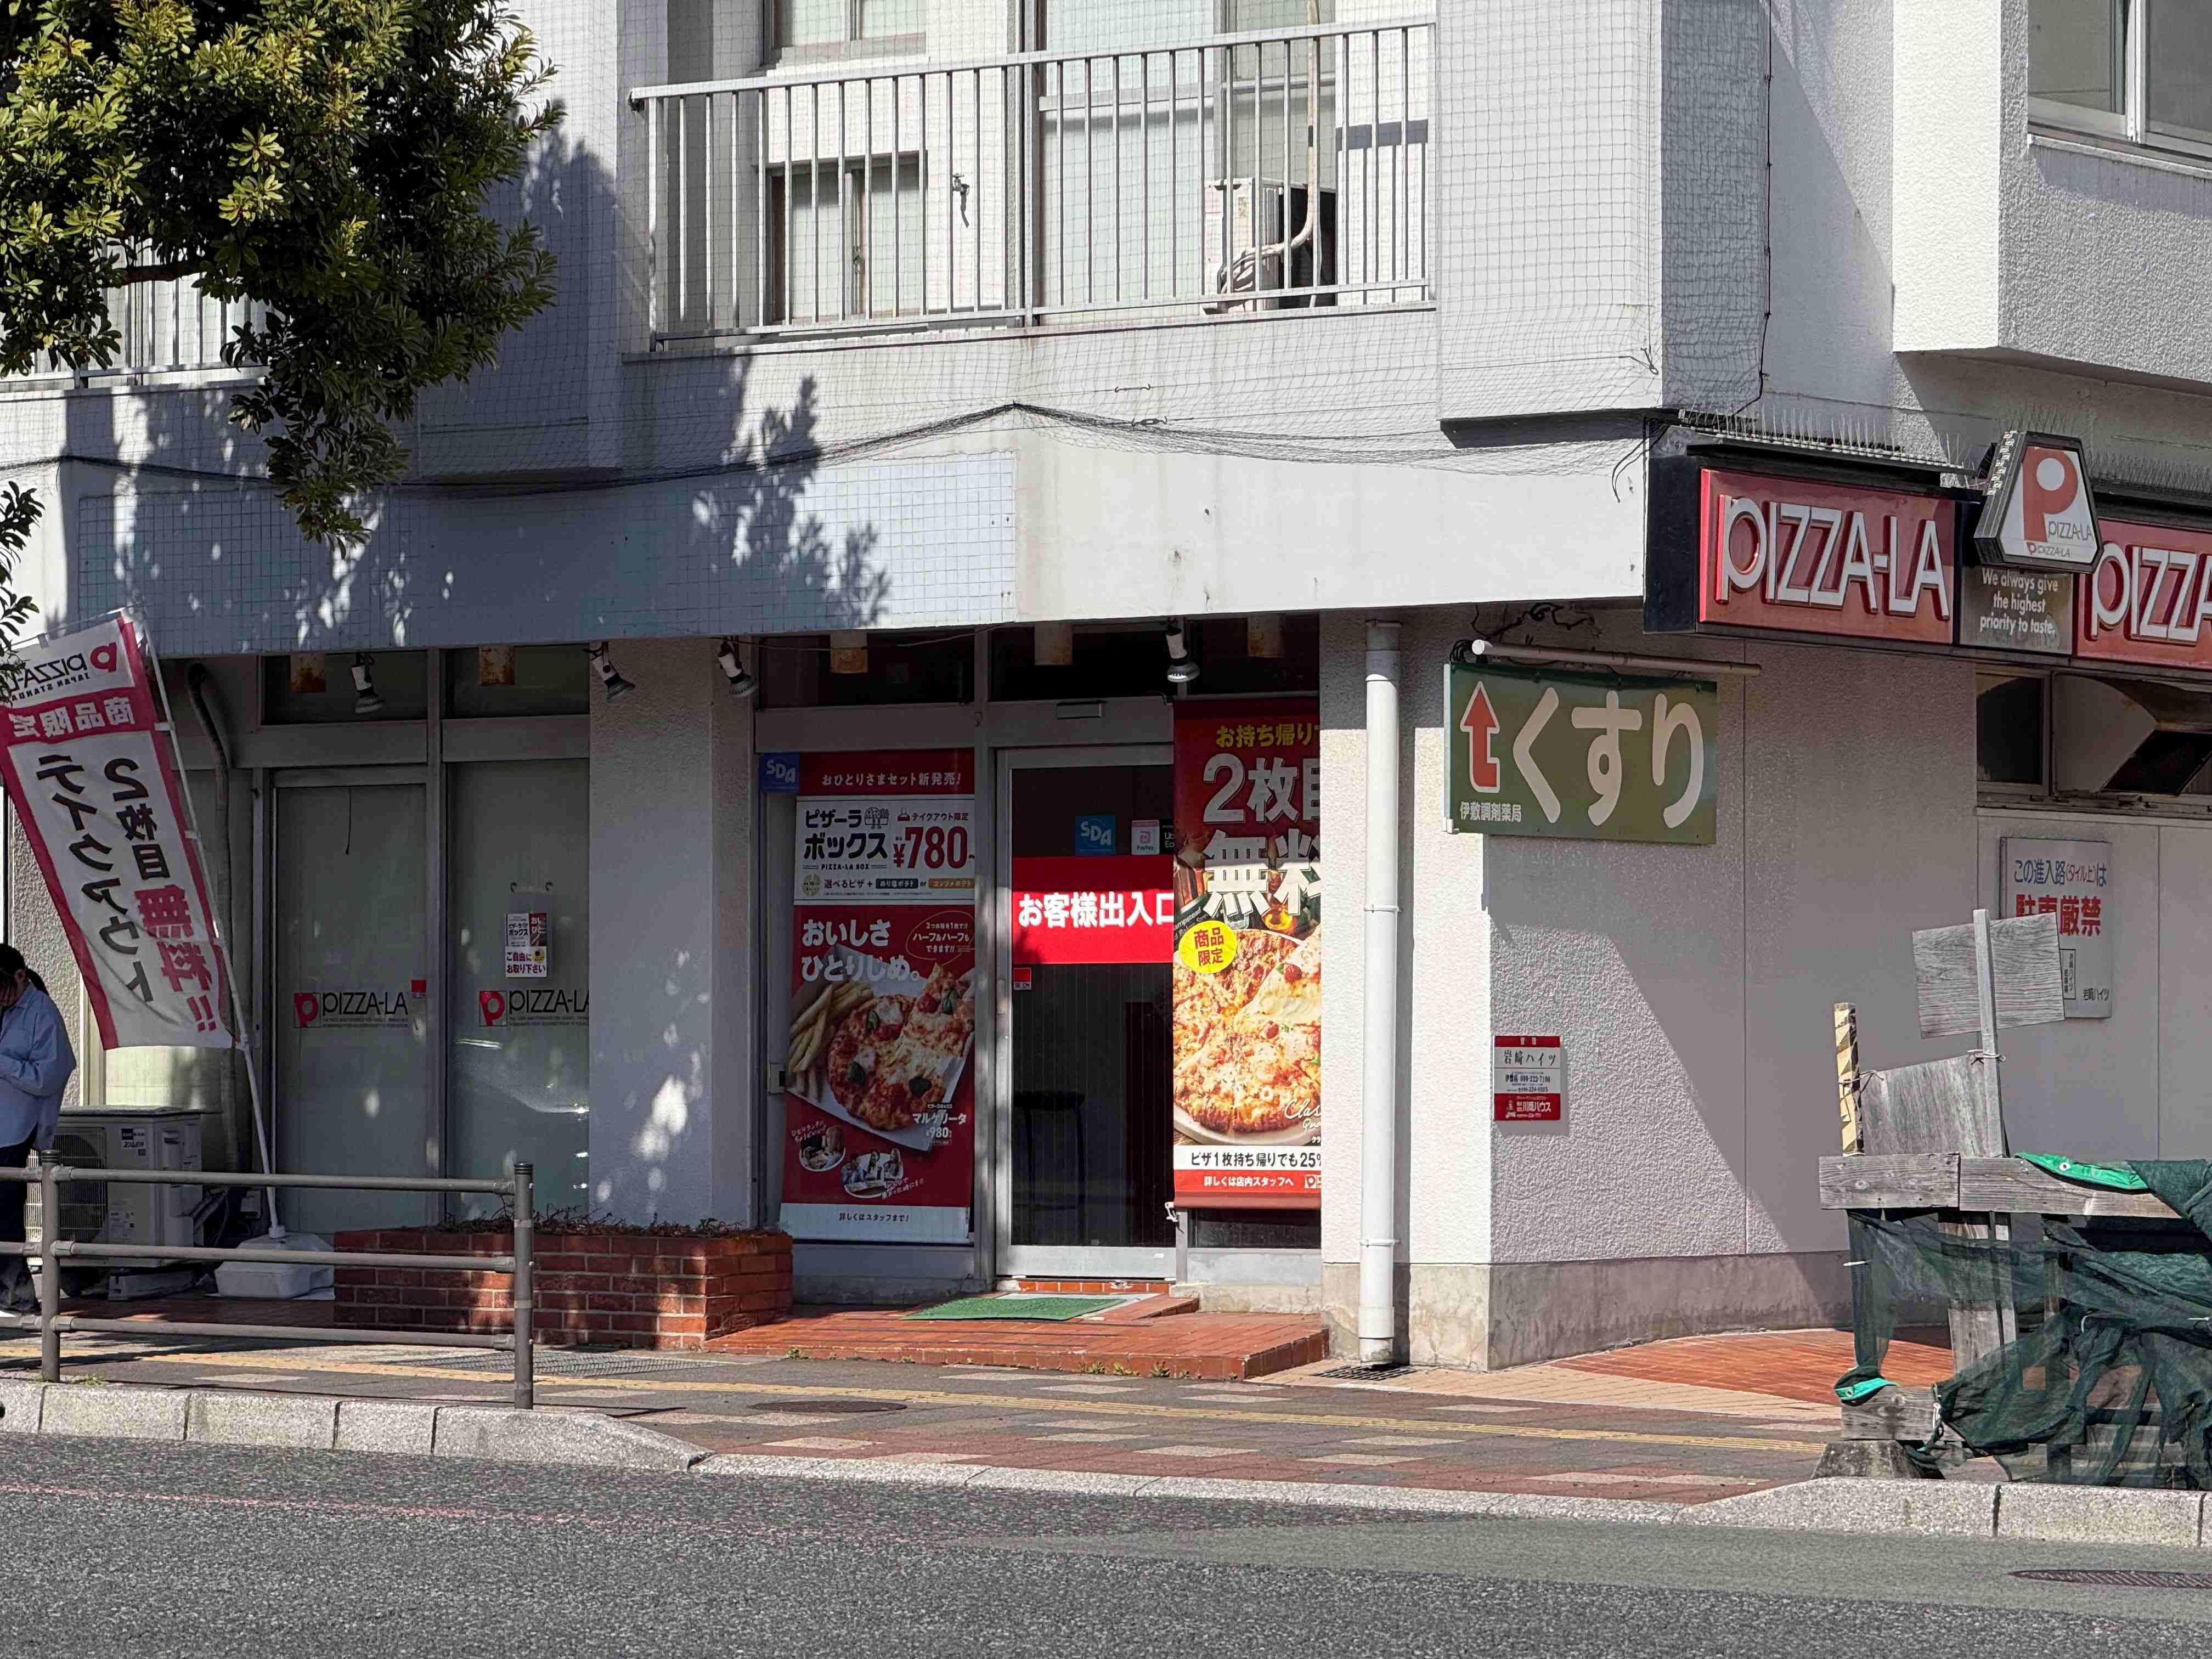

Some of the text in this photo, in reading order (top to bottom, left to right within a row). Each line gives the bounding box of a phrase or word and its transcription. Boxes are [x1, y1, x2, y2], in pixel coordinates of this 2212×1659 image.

[2048, 520, 2094, 541] PIZZA-LA
[1716, 494, 1950, 621] PIZZA-LA
[1982, 568, 2059, 593] We always give
[1993, 591, 2046, 616] the highest
[1979, 614, 2055, 635] priority to taste.
[1215, 723, 1320, 748] お持ち帰り
[1513, 686, 1704, 829] くすり
[822, 772, 961, 787] おひとりさまセット新発売!
[805, 809, 862, 829] ピザーラ
[912, 812, 969, 822] テイクアウト限定
[1460, 801, 1522, 822] 伊敷調剤薬局
[803, 832, 888, 860] ボックス
[1018, 891, 1174, 928] お客様出入口
[802, 918, 891, 948] おいしさ
[1194, 926, 1225, 949] 商品
[801, 953, 921, 983] ひとりじめ。
[1198, 947, 1224, 967] 限定
[506, 964, 546, 974] お取り下さい
[323, 991, 409, 1016] PIZZA-LA
[912, 1112, 967, 1125] マルゲリータ
[1203, 1175, 1295, 1188] 詳しくは店内スタッフへ
[838, 1211, 909, 1222] 詳しくはスタッフまで!
